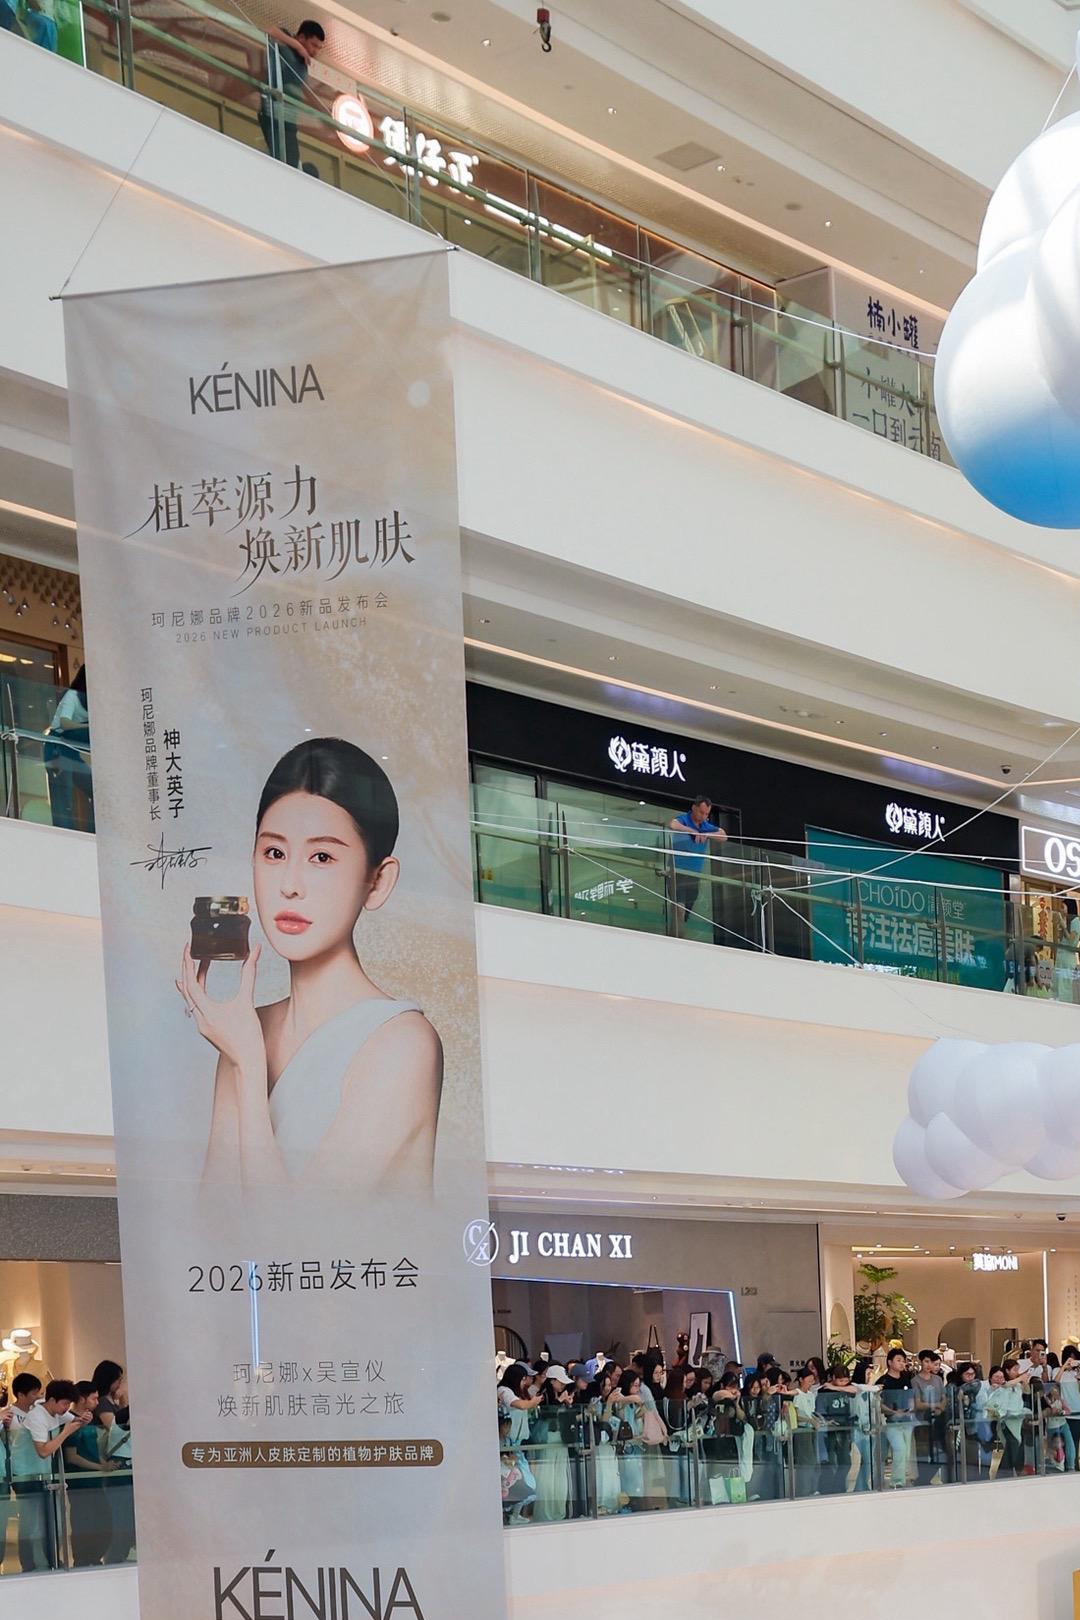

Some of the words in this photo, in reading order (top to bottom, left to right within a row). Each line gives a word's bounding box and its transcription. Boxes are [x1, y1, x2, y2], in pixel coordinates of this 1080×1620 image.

[189, 362, 325, 415] KÉNINA
[121, 464, 317, 541] 植萃源力
[230, 510, 416, 599] 焕新肌肤
[151, 592, 389, 628] 珂尼娜品牌2026新品发布会
[176, 631, 207, 643] 2026
[213, 629, 240, 641] NEW
[247, 622, 307, 638] PRODUCT
[314, 617, 367, 632] LAUNCH
[141, 687, 162, 821] 珂尼娜品牌董事长
[163, 728, 184, 819] 神大英子
[509, 1230, 530, 1264] JI
[537, 1231, 601, 1258] CHAN
[609, 1234, 632, 1259] XI
[188, 1256, 420, 1293] 2026新品发布会
[232, 1359, 386, 1386] 珂尼娜x吴宣仪
[217, 1391, 405, 1418] 焕新肌肤高光之旅
[191, 1445, 435, 1463] 专为亚洲人皮肤定制的植物护肤品牌
